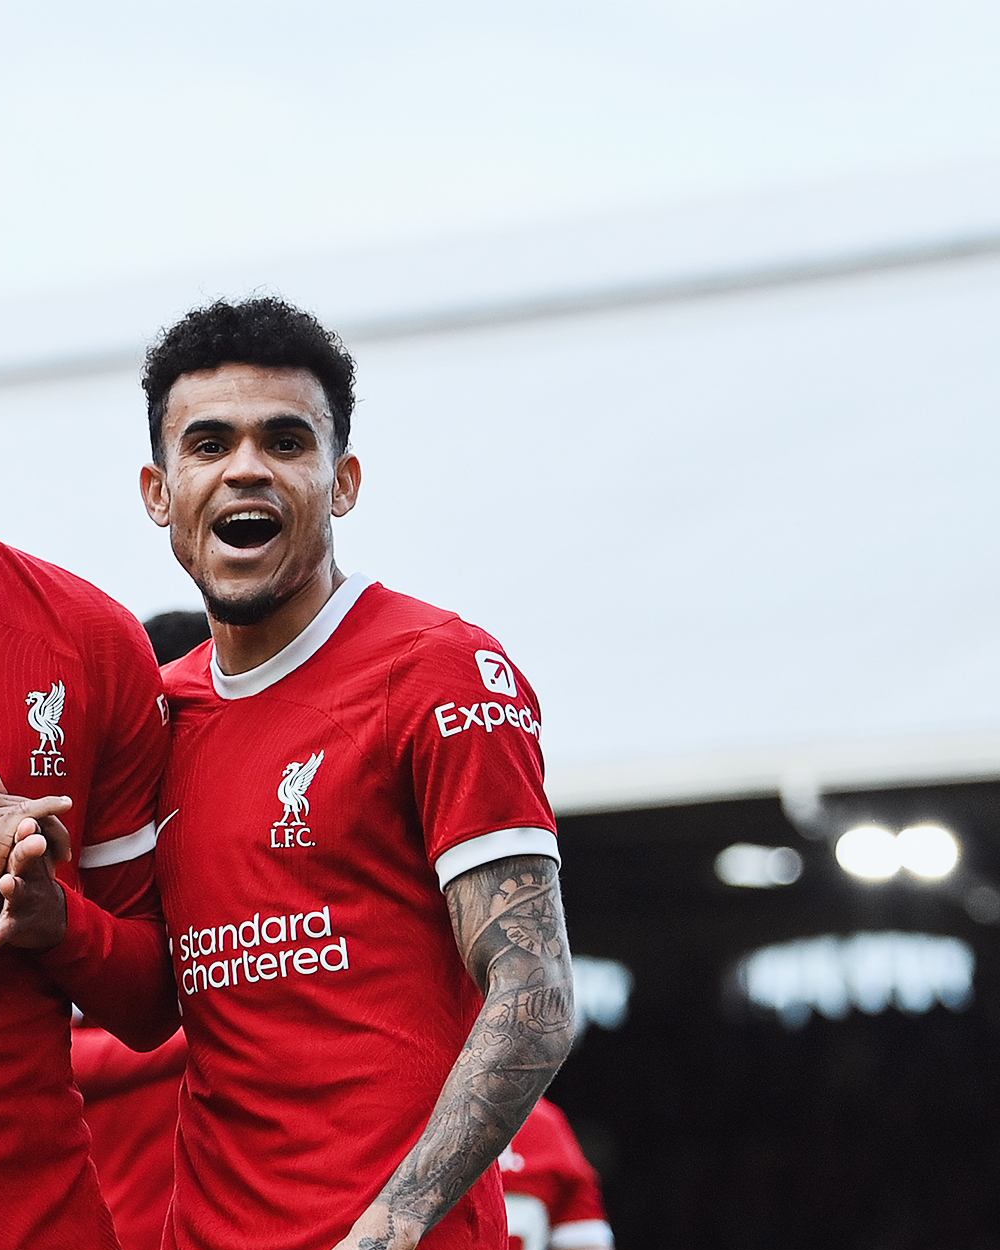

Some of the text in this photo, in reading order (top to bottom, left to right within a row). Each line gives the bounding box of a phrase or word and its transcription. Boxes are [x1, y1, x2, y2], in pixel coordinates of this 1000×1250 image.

[29, 756, 67, 777] L.F.C.
[270, 827, 316, 849] L.F.C.
[179, 905, 333, 962] standard
[182, 937, 350, 996] chartered
